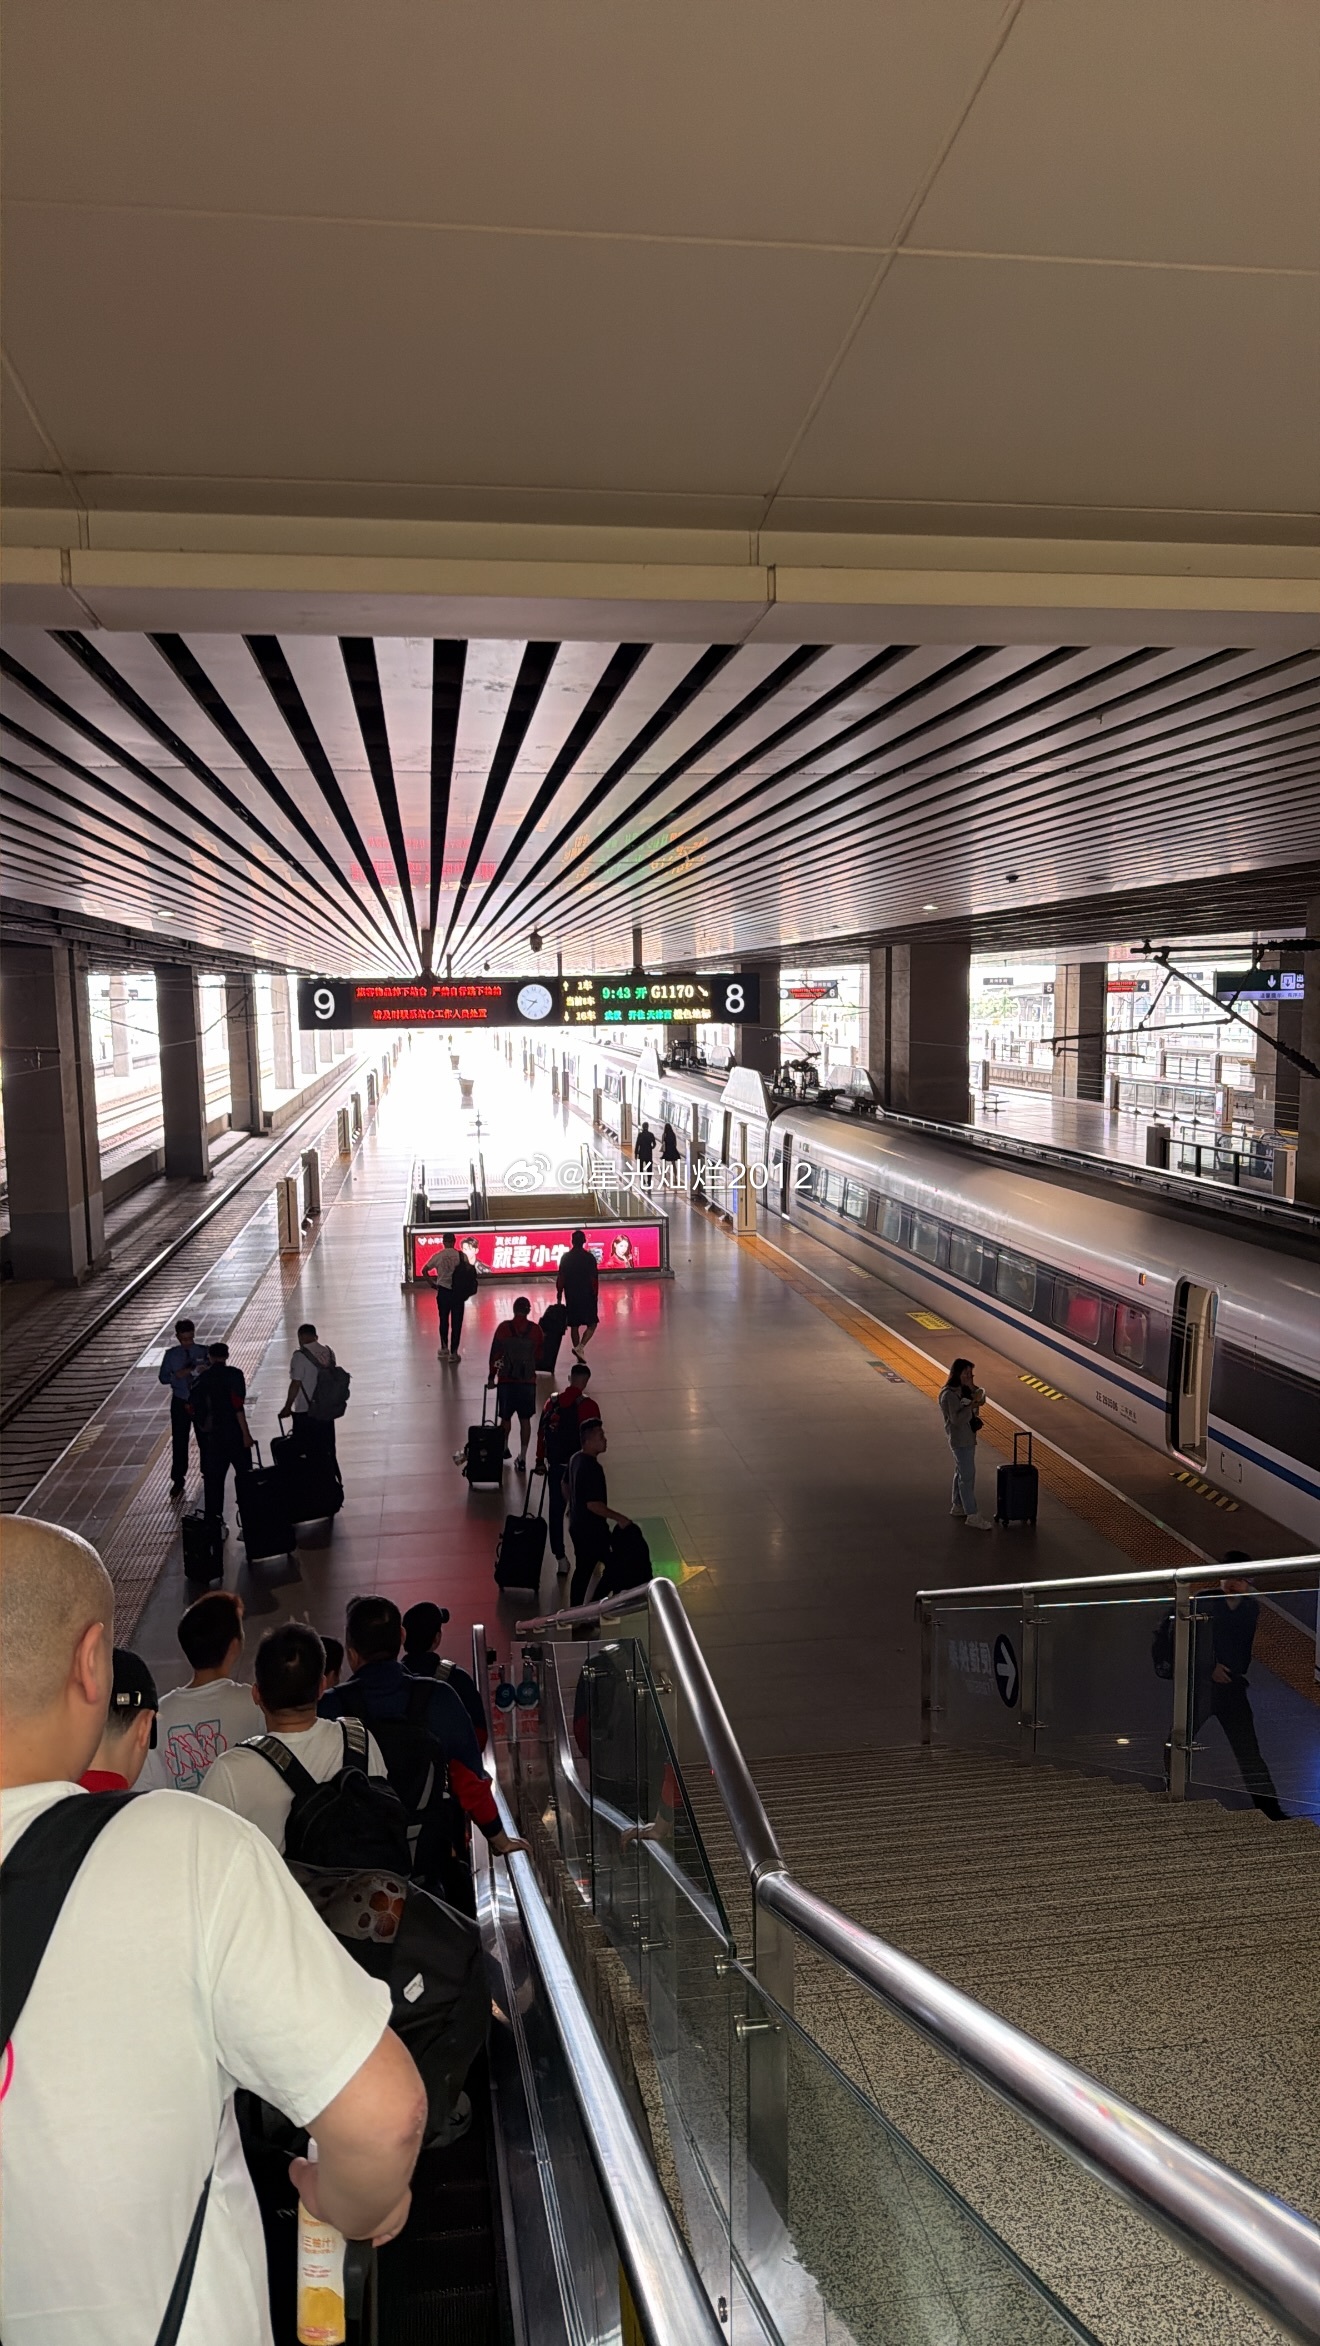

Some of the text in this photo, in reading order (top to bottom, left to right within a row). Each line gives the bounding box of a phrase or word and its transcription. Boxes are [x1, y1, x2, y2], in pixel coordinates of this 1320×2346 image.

[602, 985, 694, 999] 9:43 开 G1170
[829, 988, 836, 998] 6
[1140, 981, 1147, 991] 4
[313, 988, 336, 1020] 9
[725, 983, 745, 1014] 8
